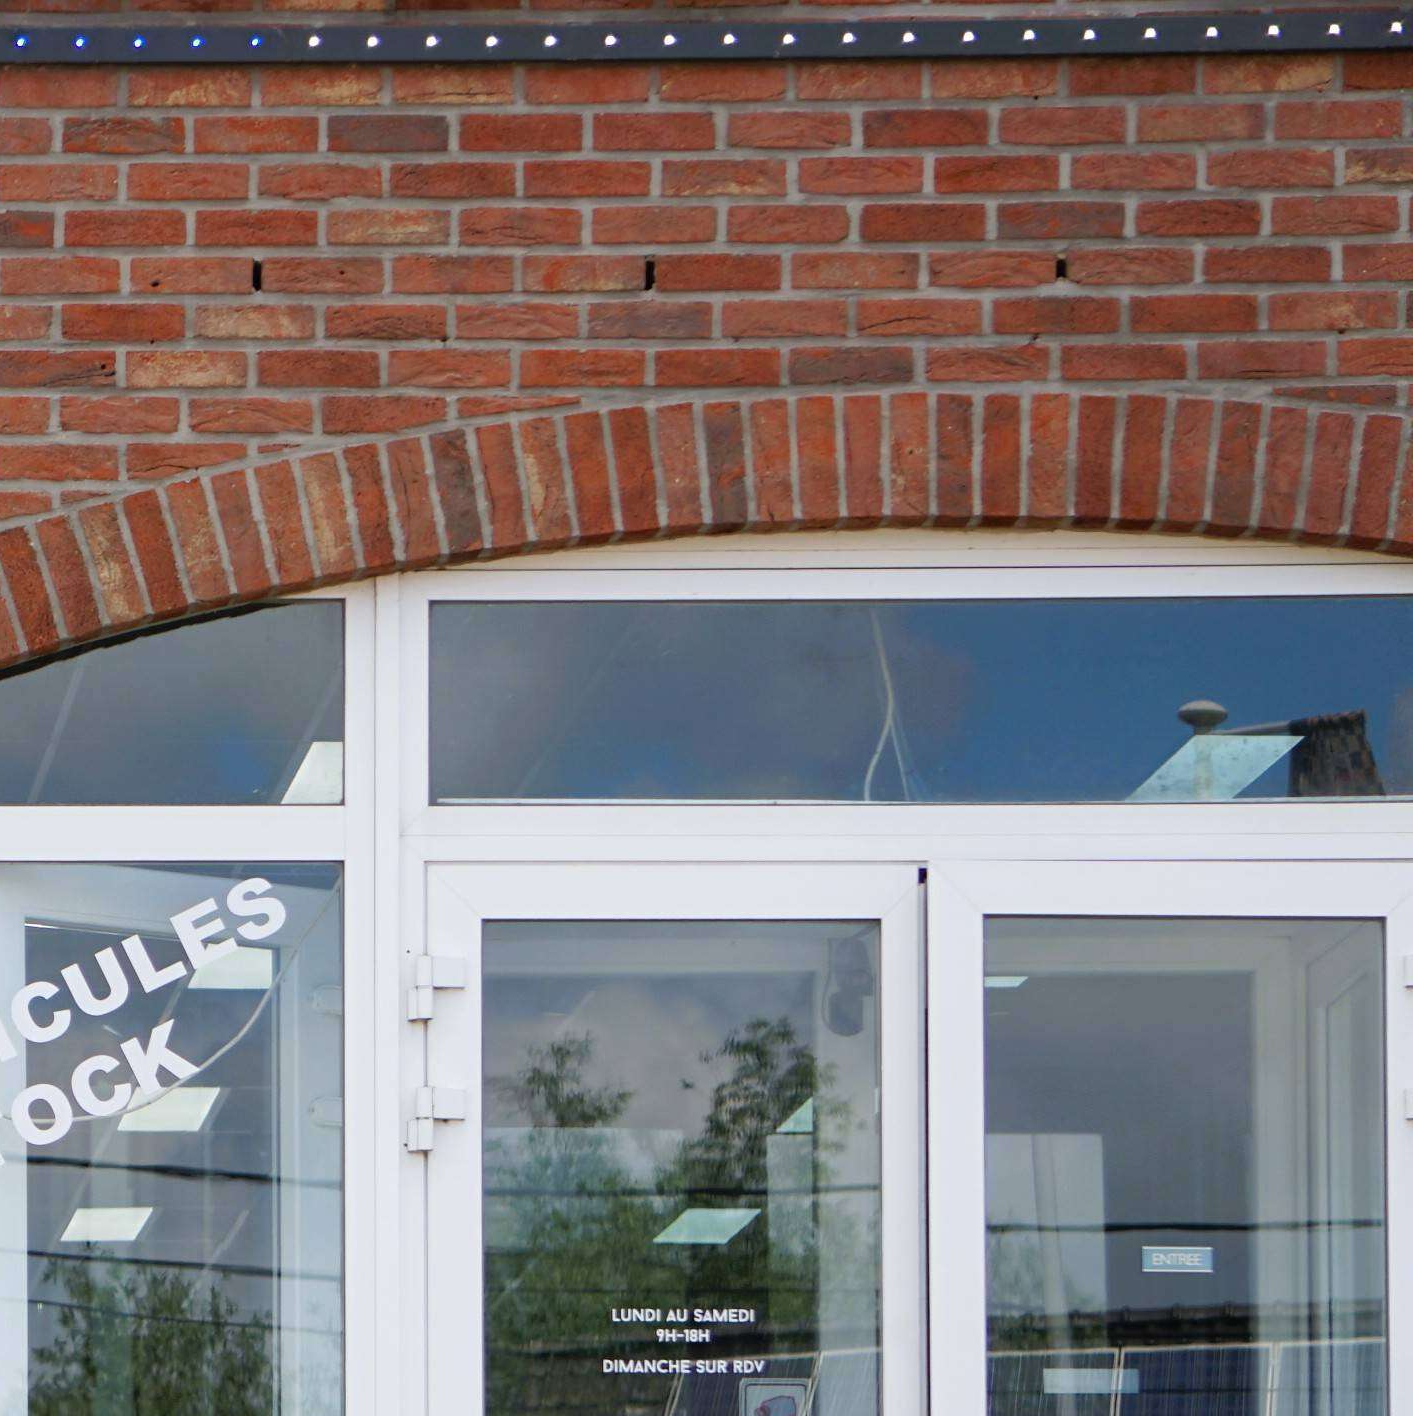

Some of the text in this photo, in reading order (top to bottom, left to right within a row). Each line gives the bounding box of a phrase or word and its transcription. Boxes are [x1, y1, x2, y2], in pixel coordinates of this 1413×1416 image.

[611, 1308, 755, 1323] LUNDI AU SAMEDI
[656, 1328, 711, 1343] 9H-18H
[602, 1359, 765, 1374] DIMANCHE SUR RDV
